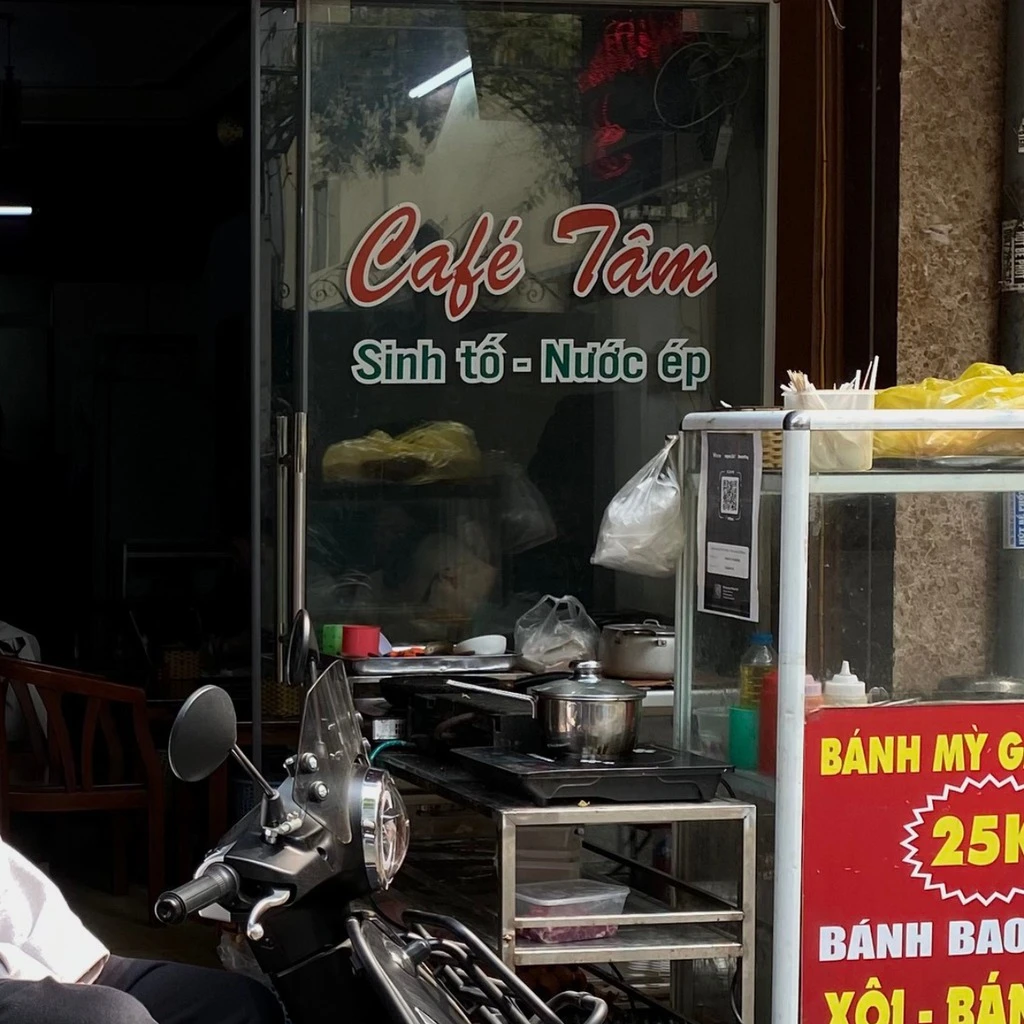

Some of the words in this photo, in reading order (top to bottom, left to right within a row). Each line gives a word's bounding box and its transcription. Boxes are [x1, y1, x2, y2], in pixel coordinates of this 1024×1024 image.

[346, 202, 526, 322] Café
[553, 203, 718, 298] Tâm
[351, 339, 446, 385] Sinh
[456, 333, 508, 385] tố
[541, 338, 647, 385] Nước
[657, 338, 711, 391] ép
[820, 728, 921, 776] BÁNH
[932, 724, 989, 772] MỲ
[997, 731, 1024, 771] G
[819, 918, 933, 962] BÁNH
[948, 917, 1024, 956] BAO
